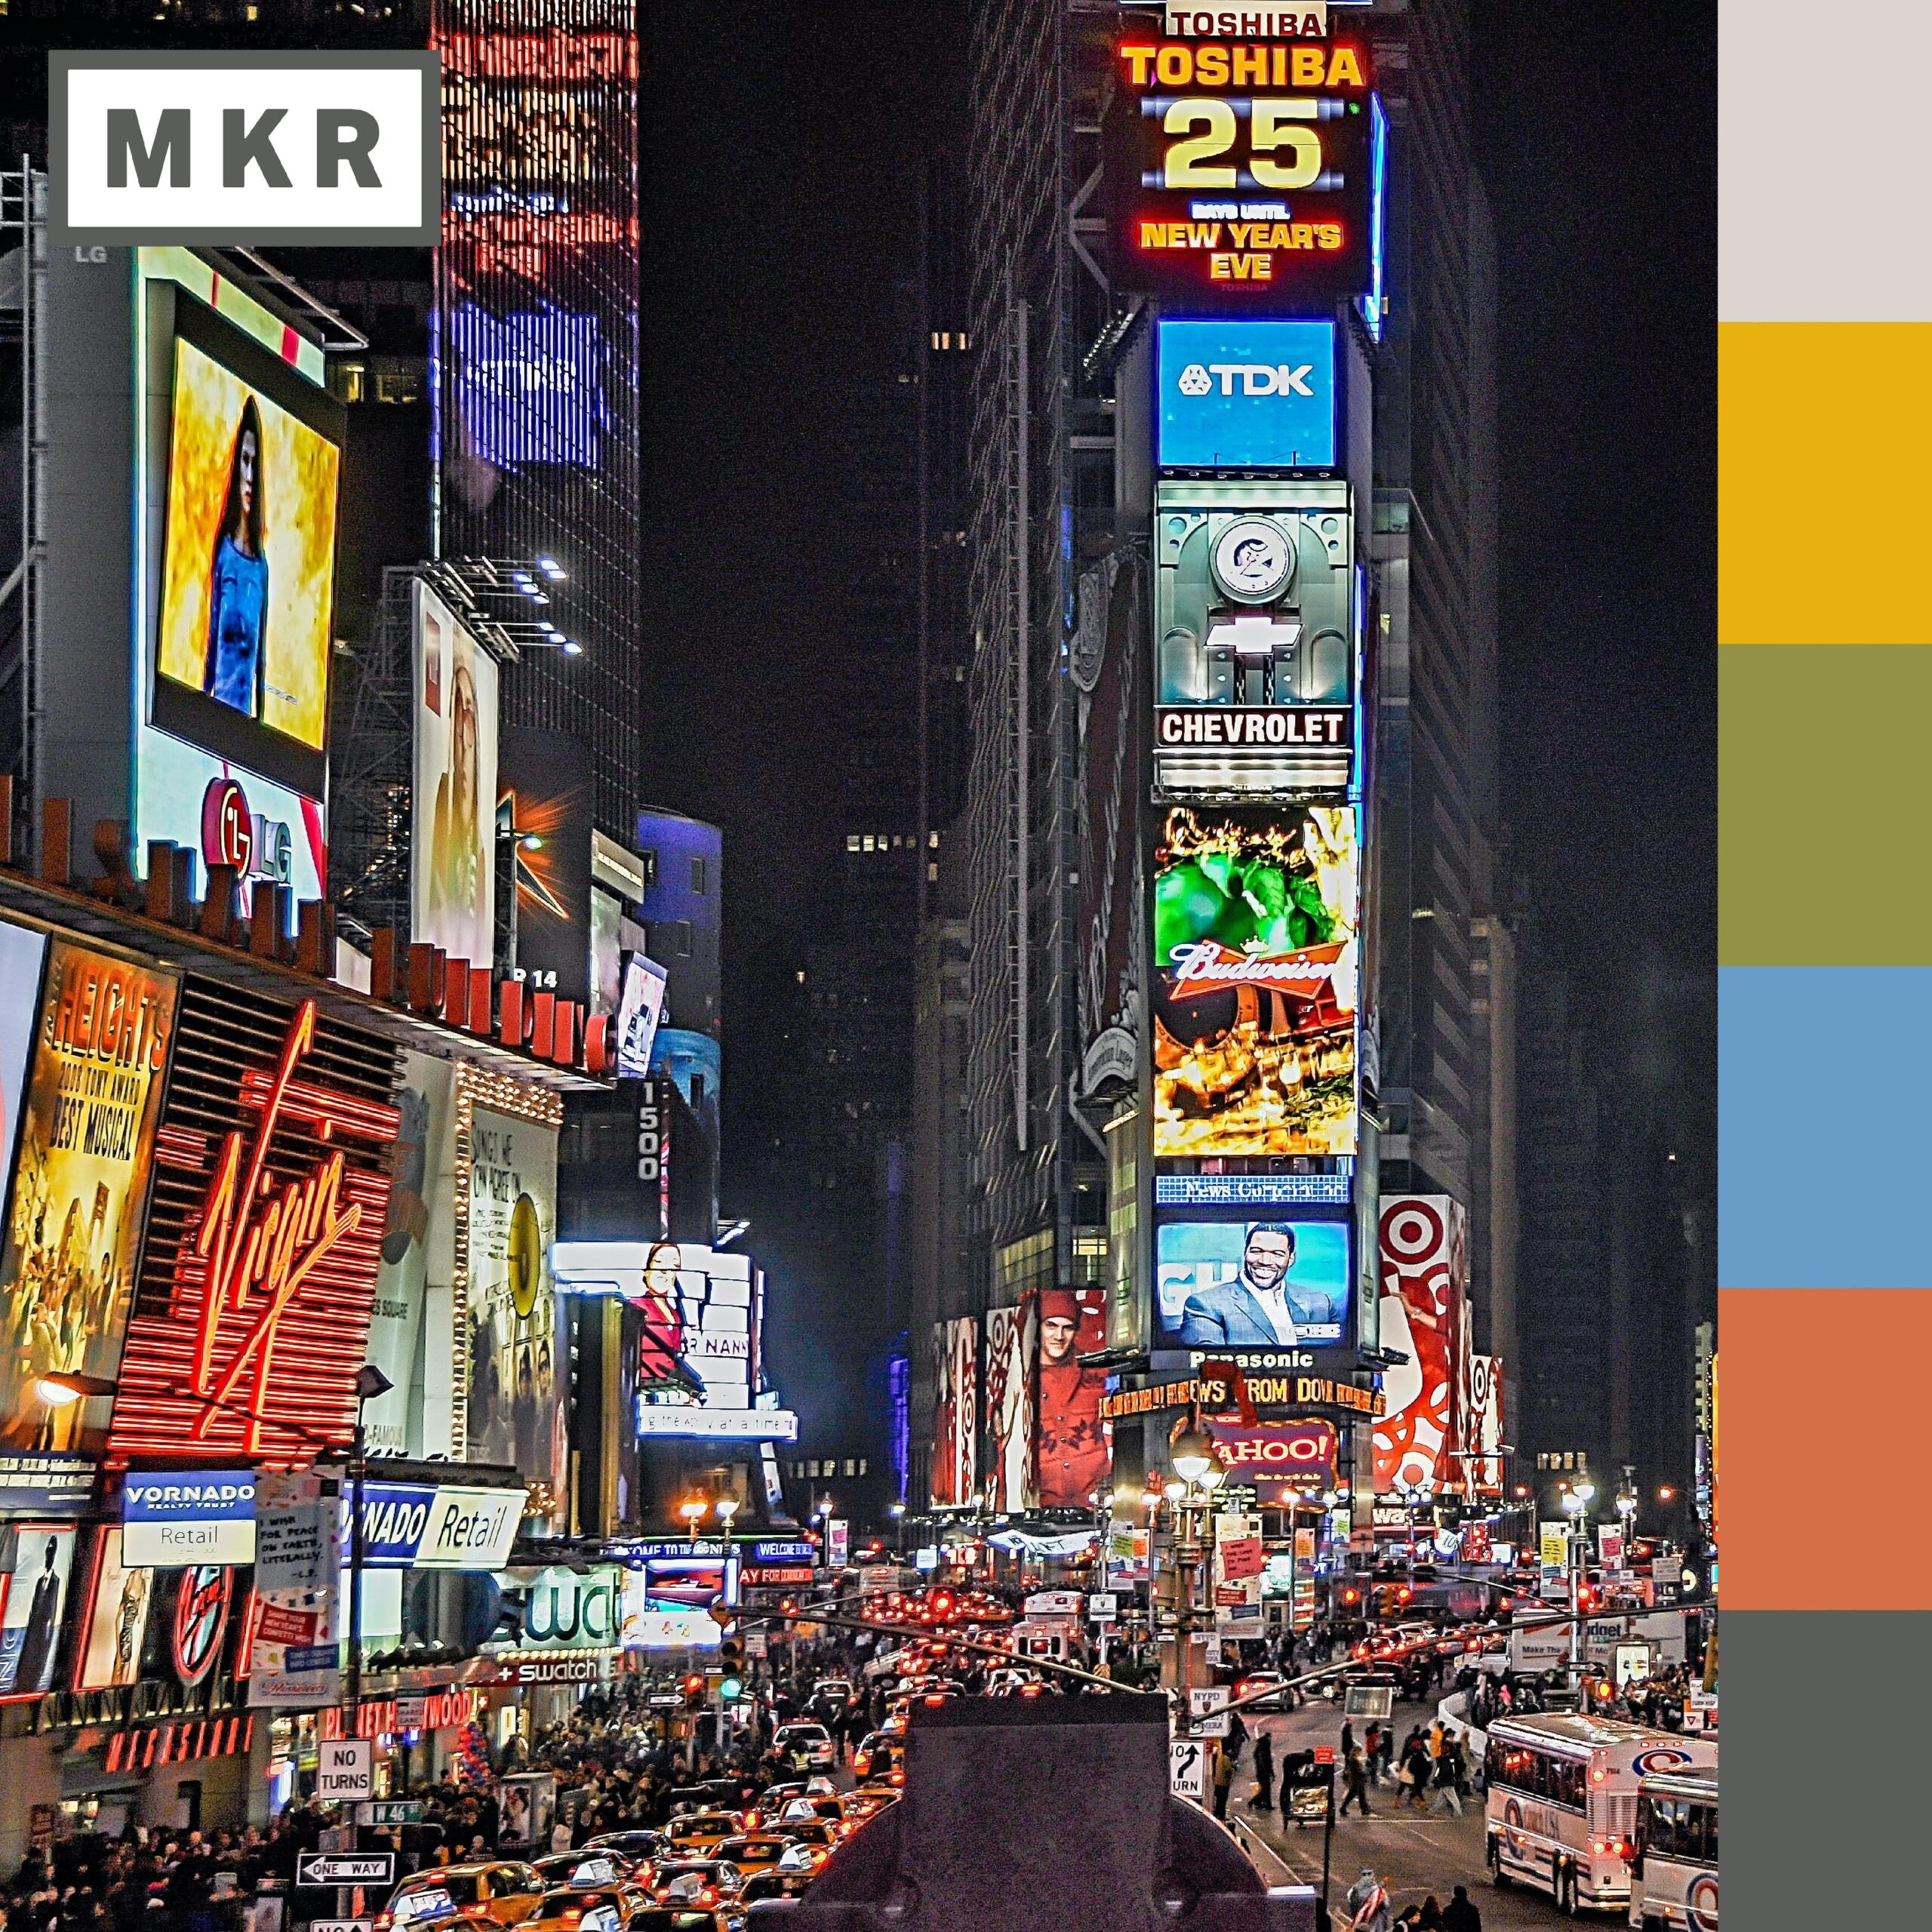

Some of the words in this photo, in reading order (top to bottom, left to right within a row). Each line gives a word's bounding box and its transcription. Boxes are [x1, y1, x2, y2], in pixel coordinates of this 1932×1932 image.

[1171, 12, 1322, 35] TOSHIBA
[1121, 46, 1364, 86] TOSHIBA
[1164, 99, 1321, 189] 25
[1141, 223, 1221, 248] NEW
[1228, 223, 1341, 249] YEAR'S
[75, 246, 106, 263] LG
[1211, 253, 1272, 279] EVE
[1208, 365, 1315, 396] TDK
[1162, 715, 1343, 743] CHEVROLET
[249, 814, 291, 884] LG
[1170, 943, 1337, 980] Budweiser
[534, 970, 557, 988] 14
[51, 963, 170, 1071] HEIGHTS
[50, 1094, 85, 1151] BEST
[84, 1102, 135, 1161] MUSICAL
[638, 1081, 659, 1180] 1500
[1183, 1181, 1231, 1198] News
[126, 1484, 255, 1503] VORNADO
[162, 1525, 218, 1544] Retail
[260, 1531, 281, 1540] FOR
[288, 1526, 319, 1537] PEACE
[341, 1499, 426, 1546] NADO
[437, 1504, 508, 1549] Retail
[519, 1660, 597, 1682] swatch
[1194, 1693, 1220, 1701] NYPD
[386, 1690, 472, 1734] HWOOD
[334, 1750, 356, 1767] NO
[321, 1774, 368, 1789] TURNS
[1174, 1781, 1198, 1791] URN
[389, 1806, 405, 1822] 46
[313, 1863, 339, 1875] ONE
[352, 1863, 380, 1875] WAY
